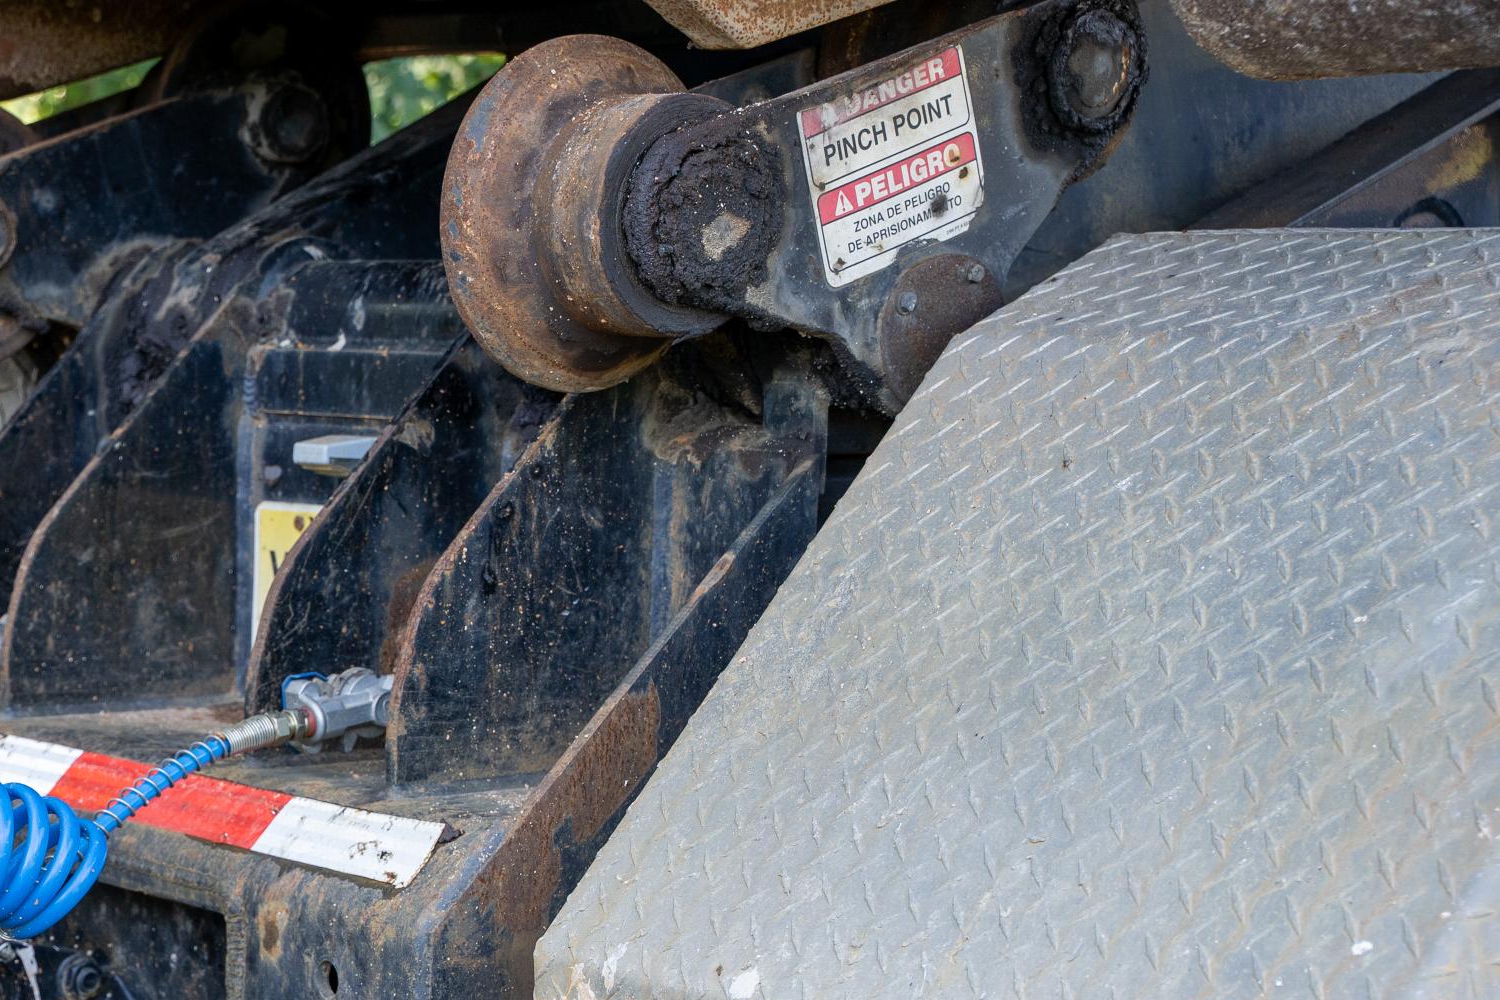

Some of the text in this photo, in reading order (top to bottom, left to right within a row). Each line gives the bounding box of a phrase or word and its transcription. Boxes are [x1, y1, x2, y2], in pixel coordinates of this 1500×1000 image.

[844, 58, 946, 117] DANGER
[823, 94, 953, 167] PINCH POINT
[854, 143, 961, 207] PELIGRO
[848, 238, 864, 254] DE
[865, 195, 963, 247] APRISIONAMTO
[854, 181, 951, 233] ZONA DE PELIGRO
